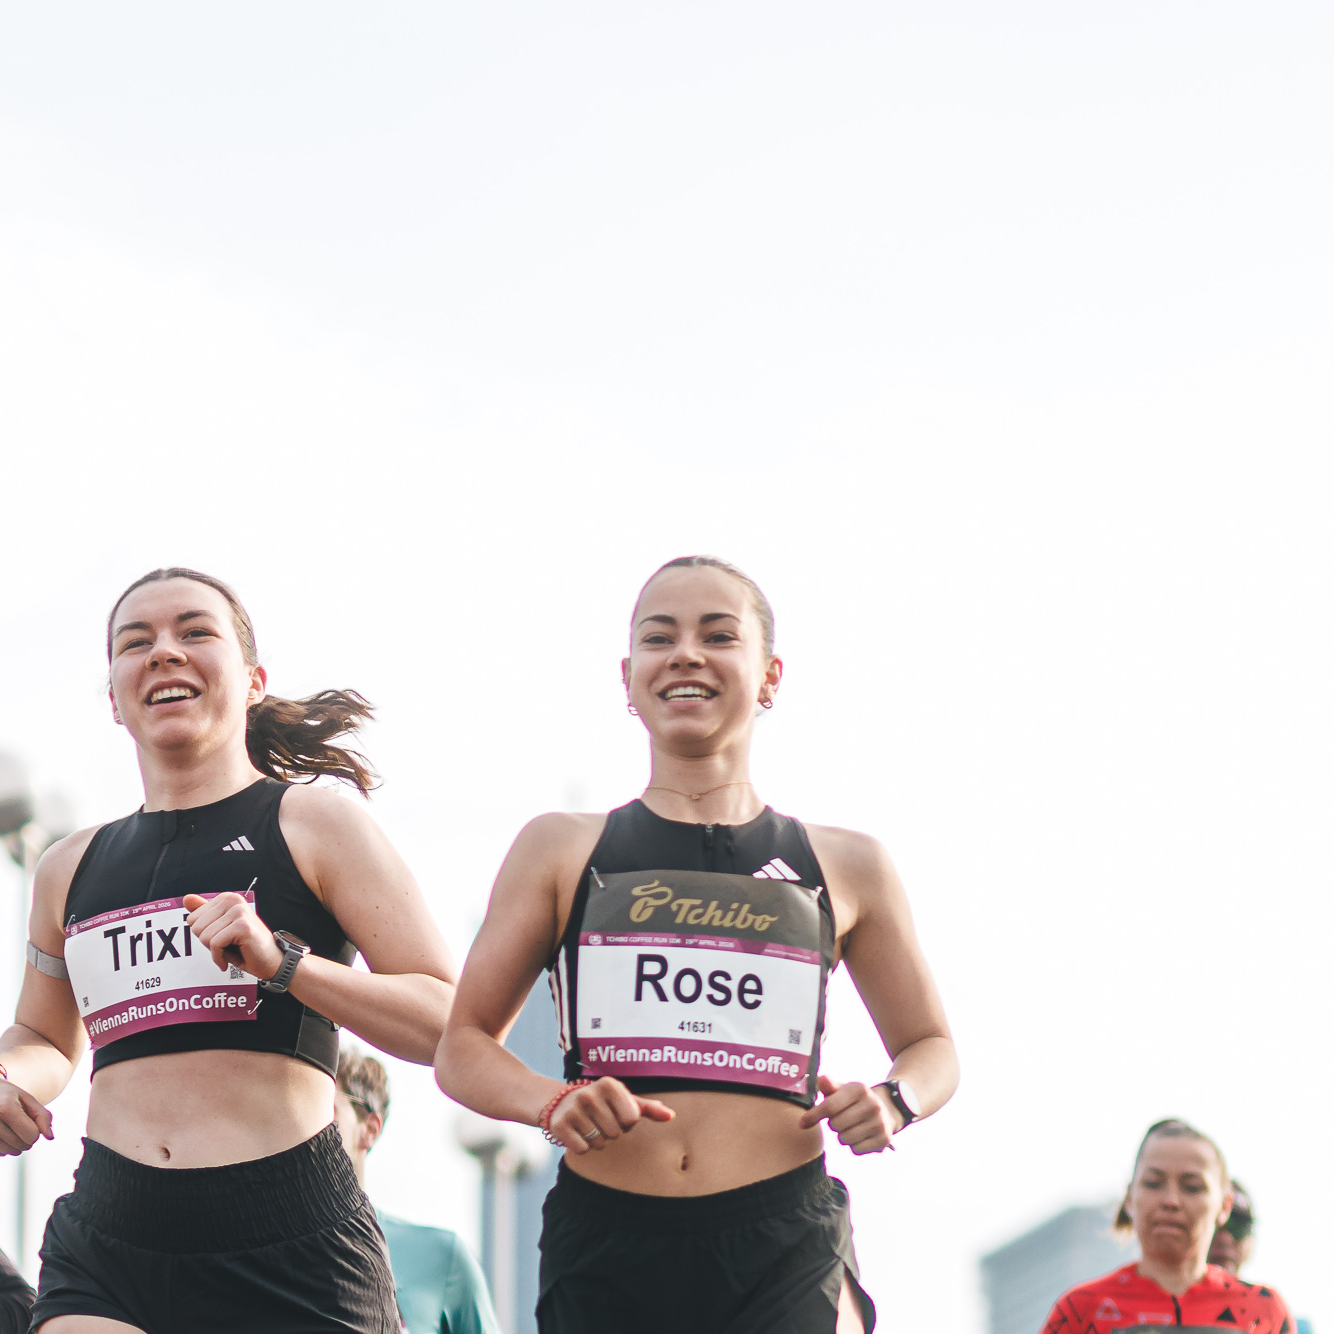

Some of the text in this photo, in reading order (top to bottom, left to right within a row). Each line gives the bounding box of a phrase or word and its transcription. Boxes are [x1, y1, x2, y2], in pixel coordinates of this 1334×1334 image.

[670, 898, 778, 931] Tchibo
[104, 914, 193, 972] Trixi
[134, 976, 161, 991] 41629
[634, 954, 763, 1010] Rose
[88, 993, 247, 1037] #ViennaRunsOnCoffee
[678, 1021, 713, 1033] 41631
[588, 1045, 799, 1078] #ViennaRunsOnCoffee
